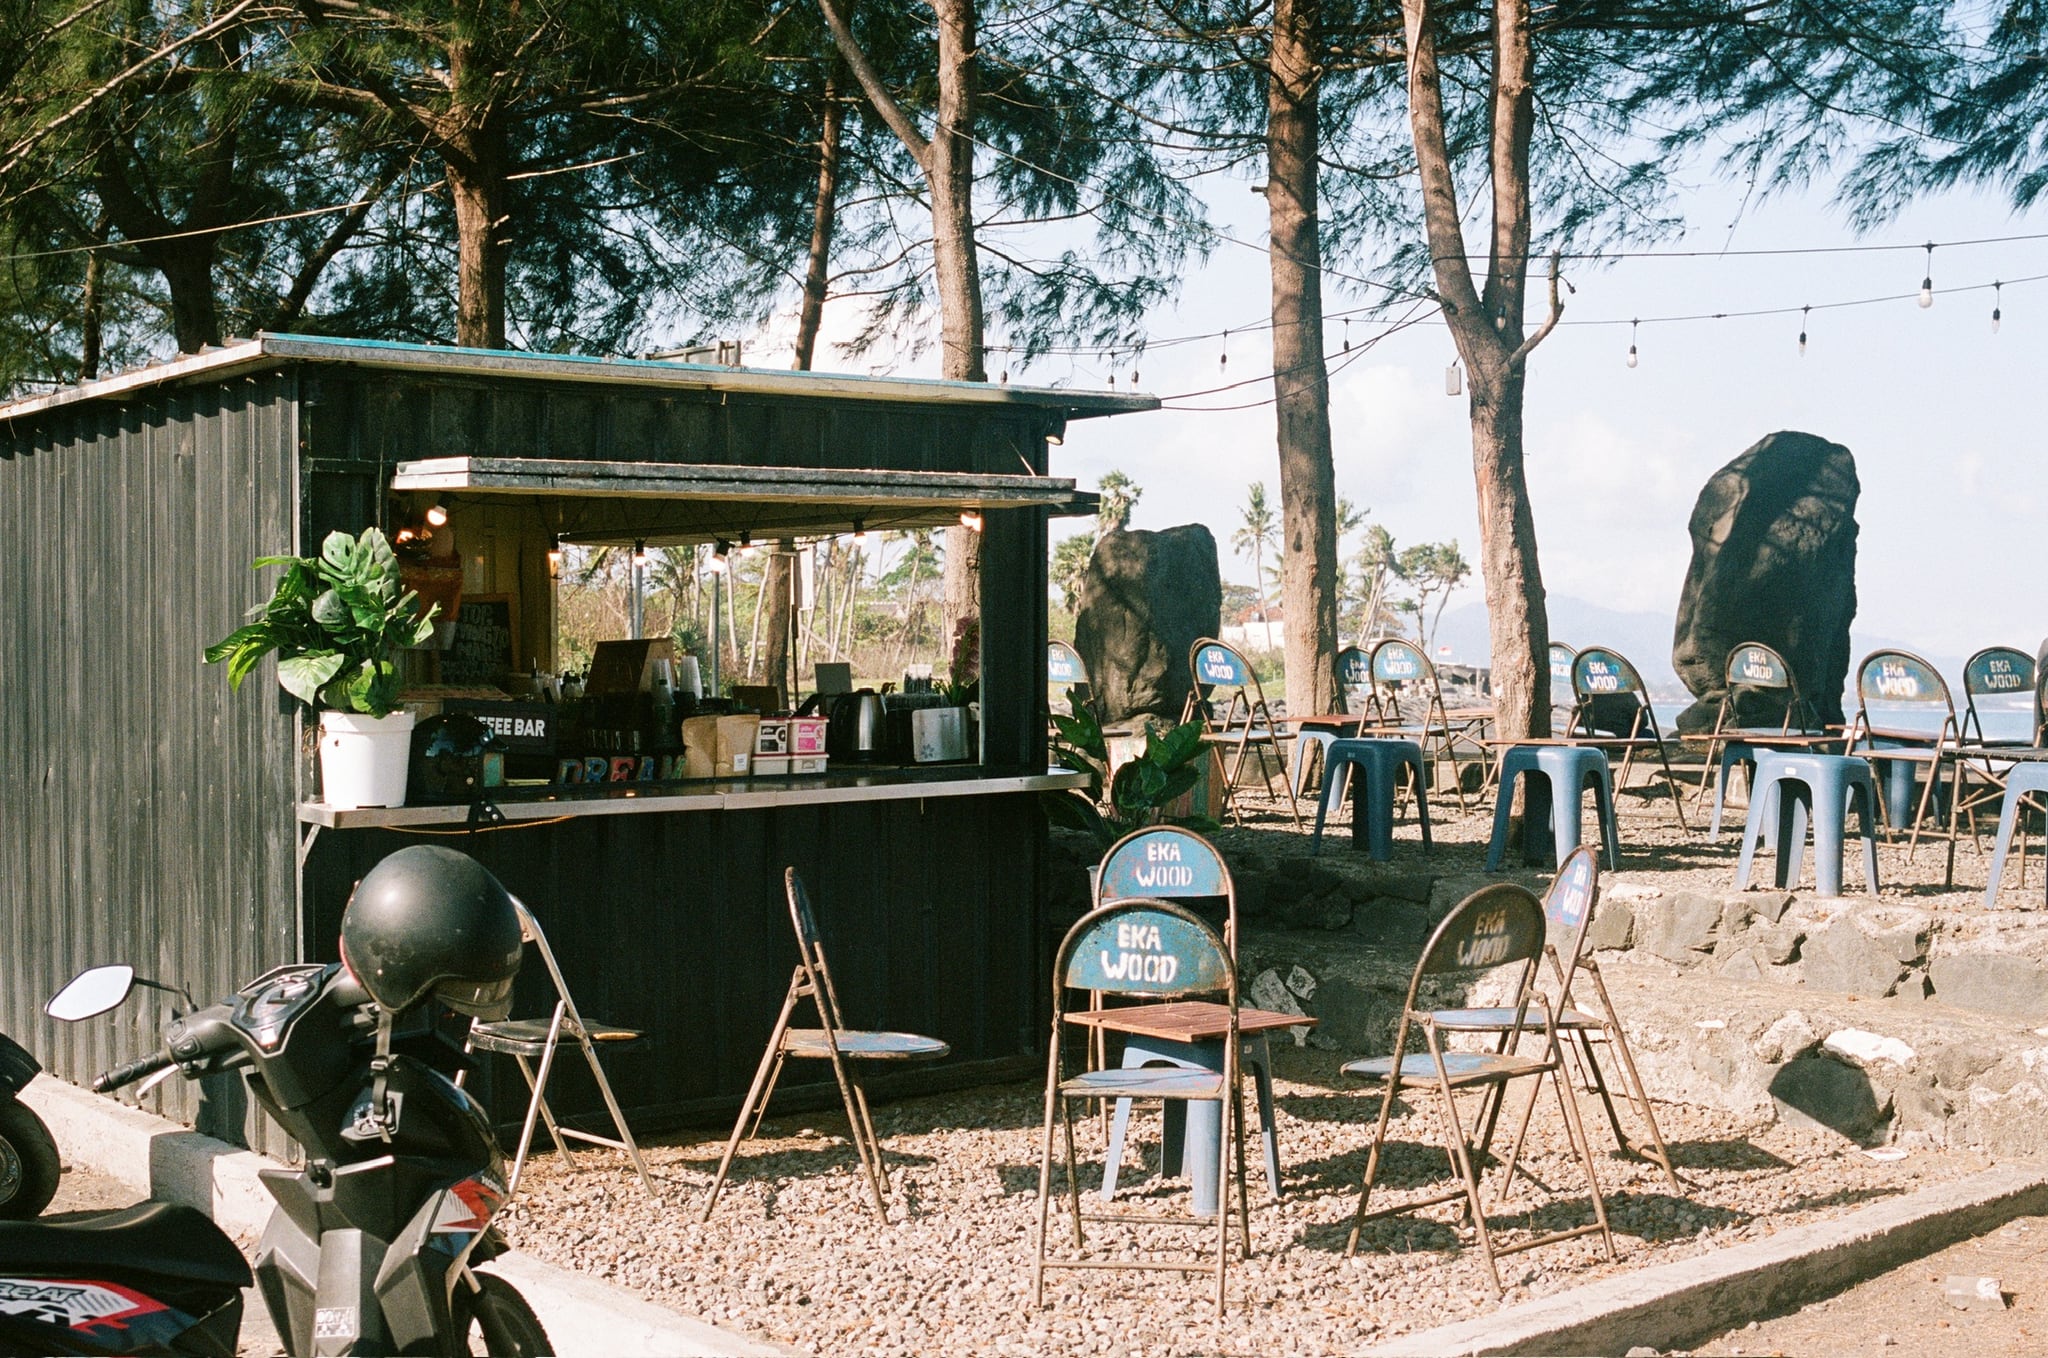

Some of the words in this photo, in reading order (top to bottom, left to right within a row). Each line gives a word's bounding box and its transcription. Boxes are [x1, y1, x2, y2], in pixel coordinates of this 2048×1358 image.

[1207, 649, 1225, 663] EKA
[1748, 650, 1767, 665] EKA
[1204, 662, 1234, 680] WOOD
[1383, 660, 1414, 675] WOOD
[1588, 661, 1609, 674] EKA
[1743, 661, 1773, 680] WOOD
[1882, 661, 1906, 677] EKA
[1989, 659, 2012, 673] EKA
[1585, 674, 1618, 690] WOOD
[1876, 675, 1918, 697] WOOD
[1984, 673, 2021, 689] WOOD
[514, 718, 545, 737] BAR
[1146, 841, 1182, 862] EKA
[1135, 865, 1193, 887] WOOD
[1474, 908, 1507, 935] EKA
[1118, 922, 1162, 951] EKA
[1458, 934, 1511, 967] WOOD
[1101, 950, 1177, 983] WOOD
